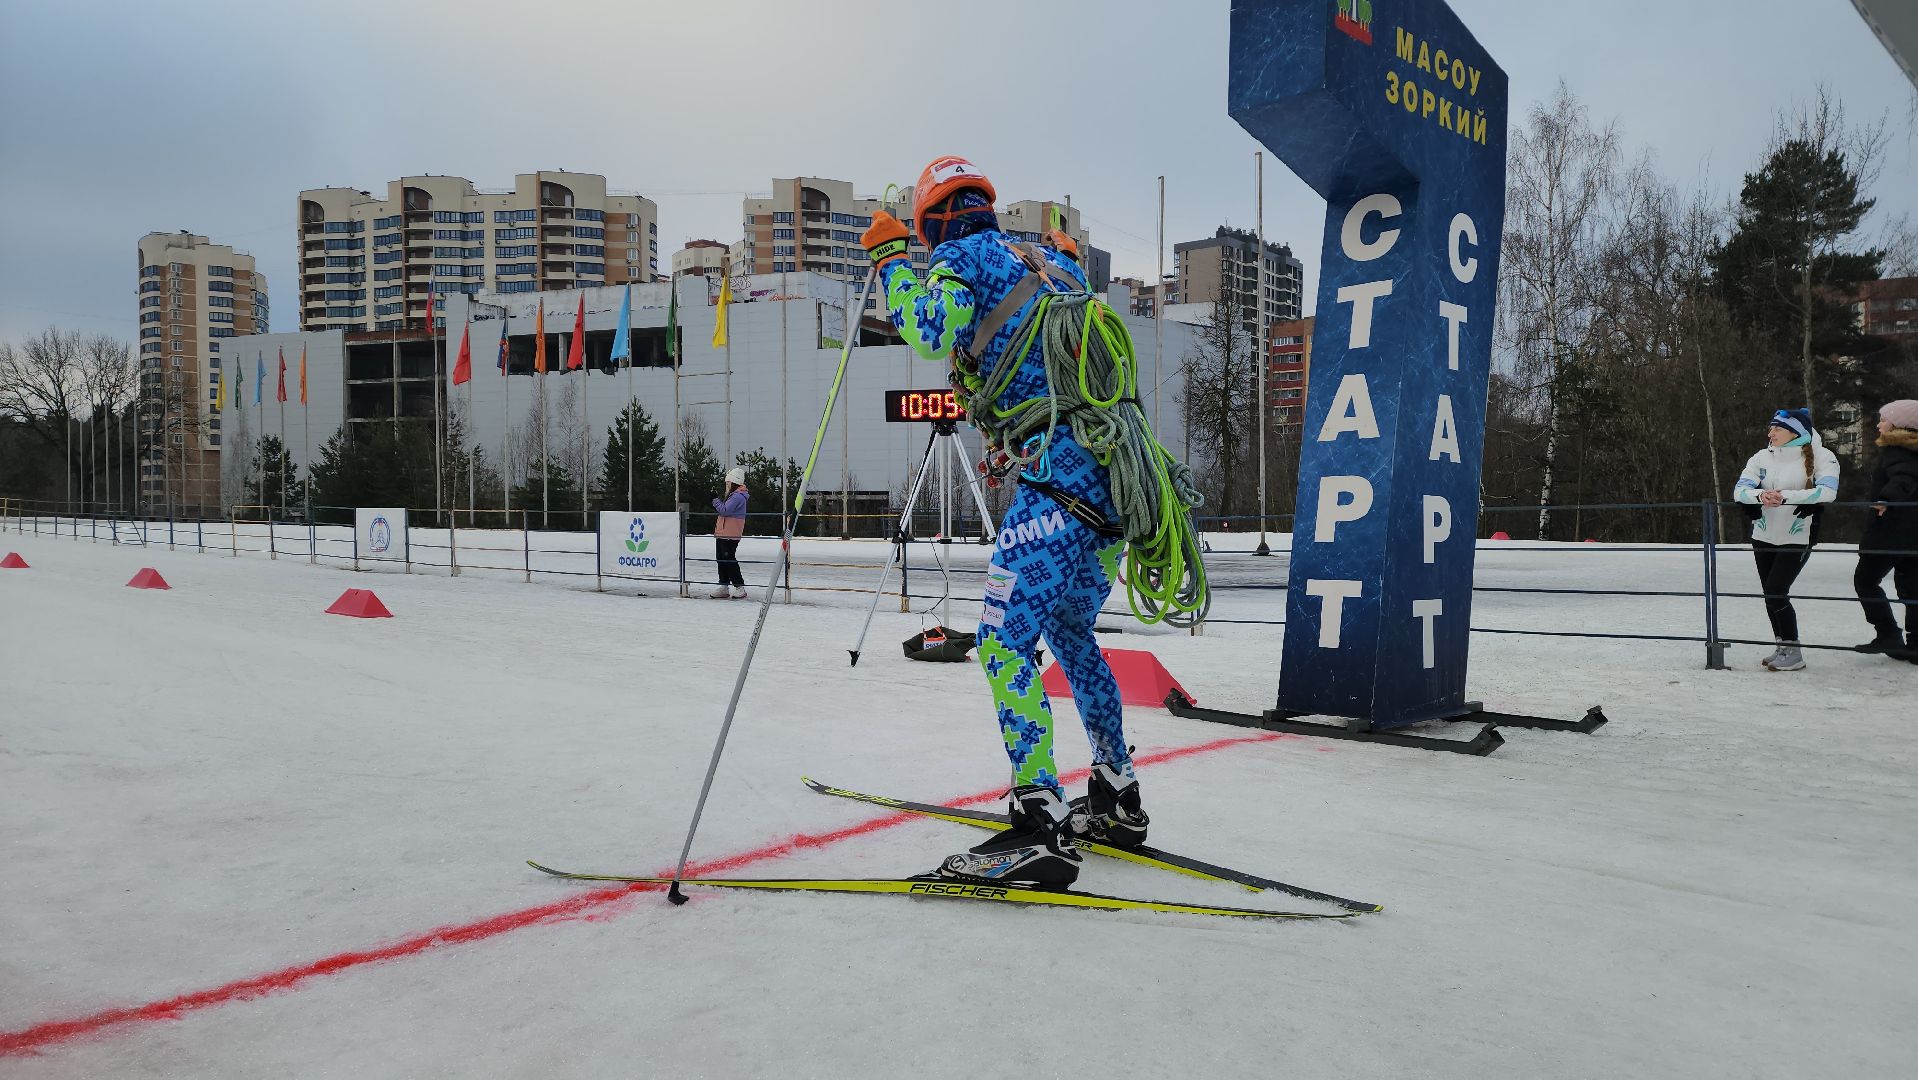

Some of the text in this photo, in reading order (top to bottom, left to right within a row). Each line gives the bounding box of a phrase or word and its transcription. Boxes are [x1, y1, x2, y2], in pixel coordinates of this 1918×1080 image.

[1396, 26, 1481, 96] МАСОУ
[1385, 71, 1488, 145] ЗОРКИЙ
[955, 165, 965, 173] 4
[876, 244, 896, 257] HIDE
[1306, 193, 1402, 648] СТАРТ
[1412, 212, 1478, 669] СТАРТ
[618, 556, 657, 568] ФОСАГРО
[909, 883, 1008, 899] FISCHER
